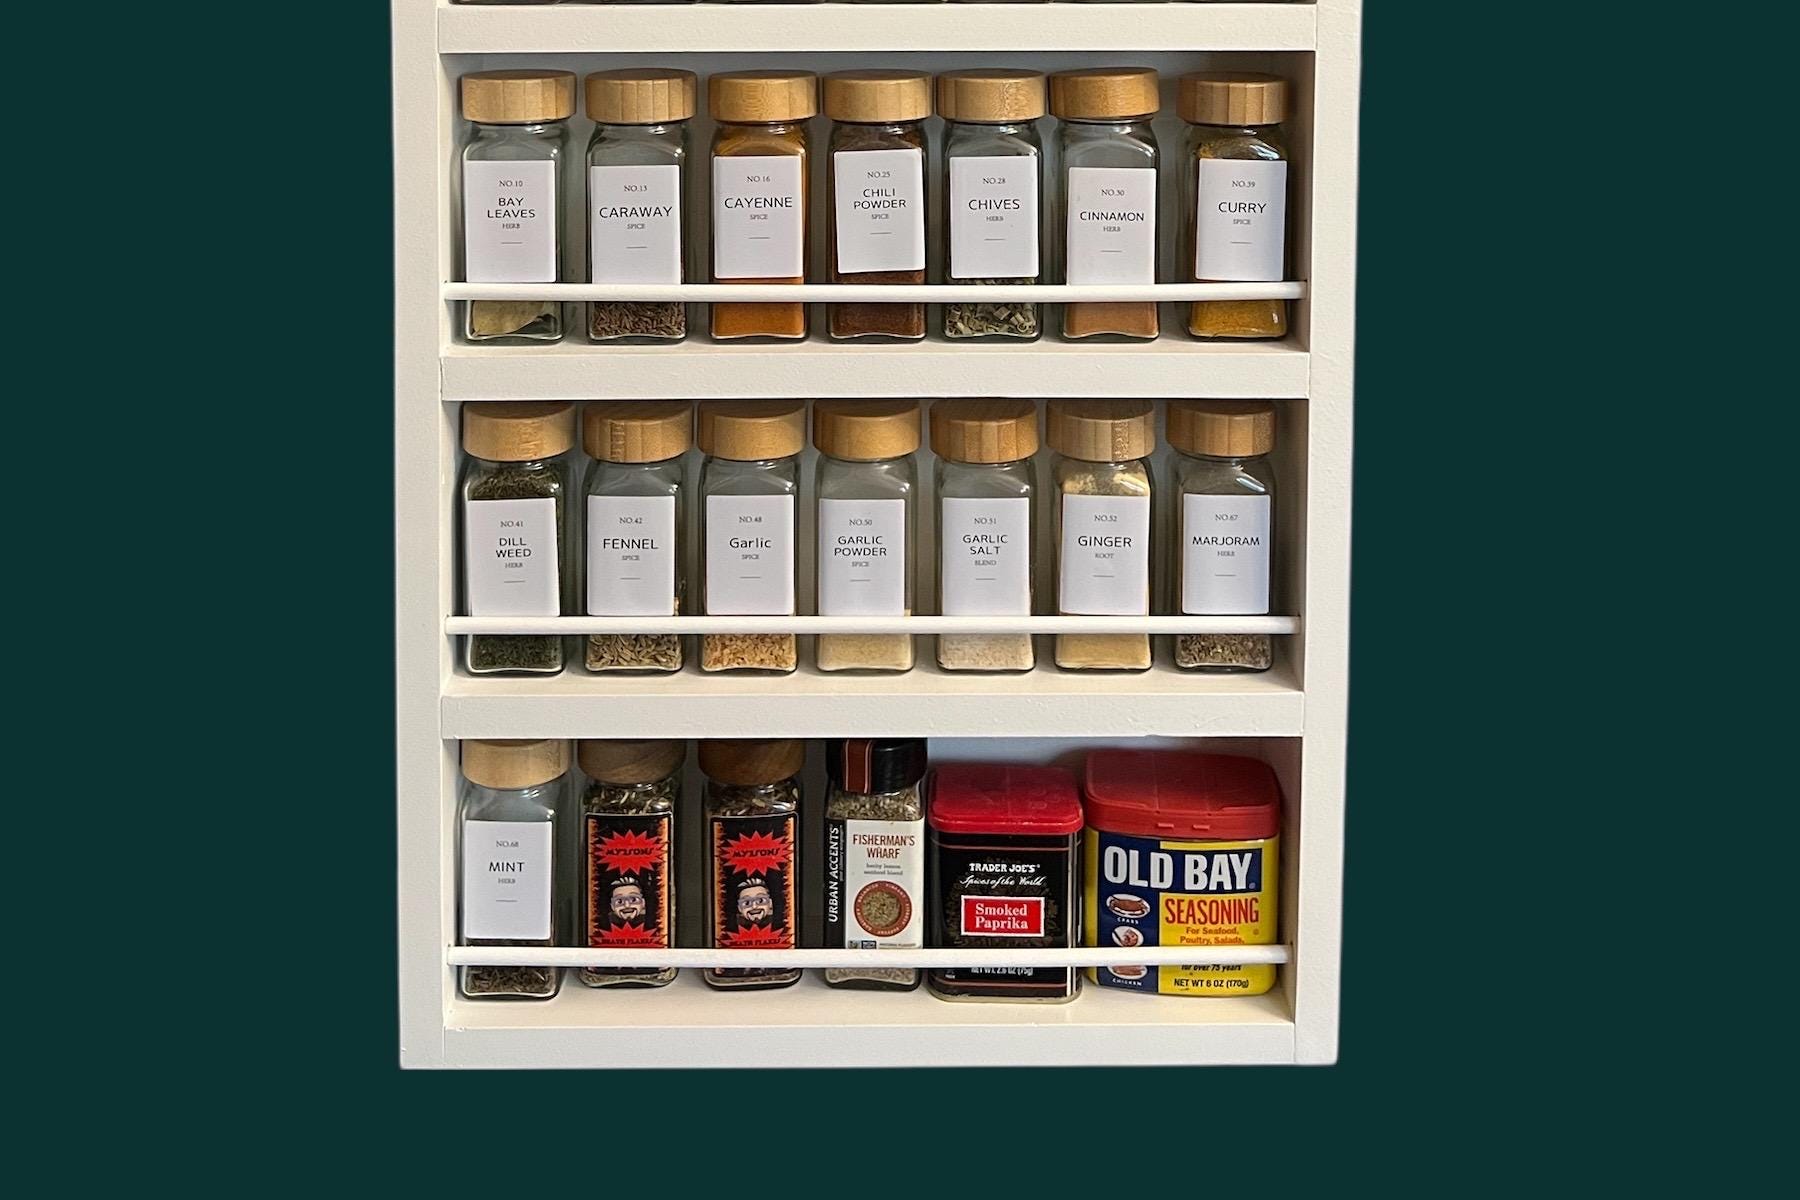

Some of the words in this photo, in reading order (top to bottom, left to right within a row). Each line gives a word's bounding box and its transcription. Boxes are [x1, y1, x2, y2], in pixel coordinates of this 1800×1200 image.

[863, 188, 896, 198] CHILI
[498, 197, 524, 207] BAY
[724, 197, 793, 209] CAYENNE
[853, 200, 907, 210] POWDER
[968, 199, 1021, 210] CHIVES
[1218, 202, 1267, 213] CURRY
[487, 209, 536, 219] LEAVES
[599, 206, 672, 218] CARAWAY
[1079, 211, 1144, 222] CINNAMON
[499, 538, 527, 547] DILL
[603, 538, 660, 550] FENNEL
[729, 537, 772, 549] Garlic
[838, 536, 882, 546] GARLIC
[963, 534, 1008, 544] GARLIC
[1078, 535, 1132, 548] GINGER
[1192, 536, 1260, 546] MARJORAM
[495, 548, 532, 558] WEED
[834, 547, 887, 557] POWDER
[970, 546, 1001, 555] SALT
[852, 834, 916, 847] FISHERMAN'S
[828, 827, 840, 878] ACCENTS
[866, 848, 902, 860] WHARF
[488, 861, 525, 872] MINT
[968, 862, 1007, 873] TRADER
[1008, 863, 1036, 873] JOE'S
[1103, 845, 1174, 890] OLD
[1184, 852, 1253, 892] BAY
[828, 881, 839, 923] URBAN
[975, 903, 1028, 917] Smoked
[1164, 897, 1259, 925] SEASONING
[975, 916, 1029, 931] Paprika
[1185, 927, 1201, 935] For
[1193, 964, 1210, 972] over
[1221, 964, 1242, 974] years
[1174, 978, 1189, 988] NET
[1190, 978, 1205, 988] WT
[1206, 979, 1212, 987] 6
[1213, 979, 1224, 987] OZ
[1225, 978, 1250, 989] (170g)
